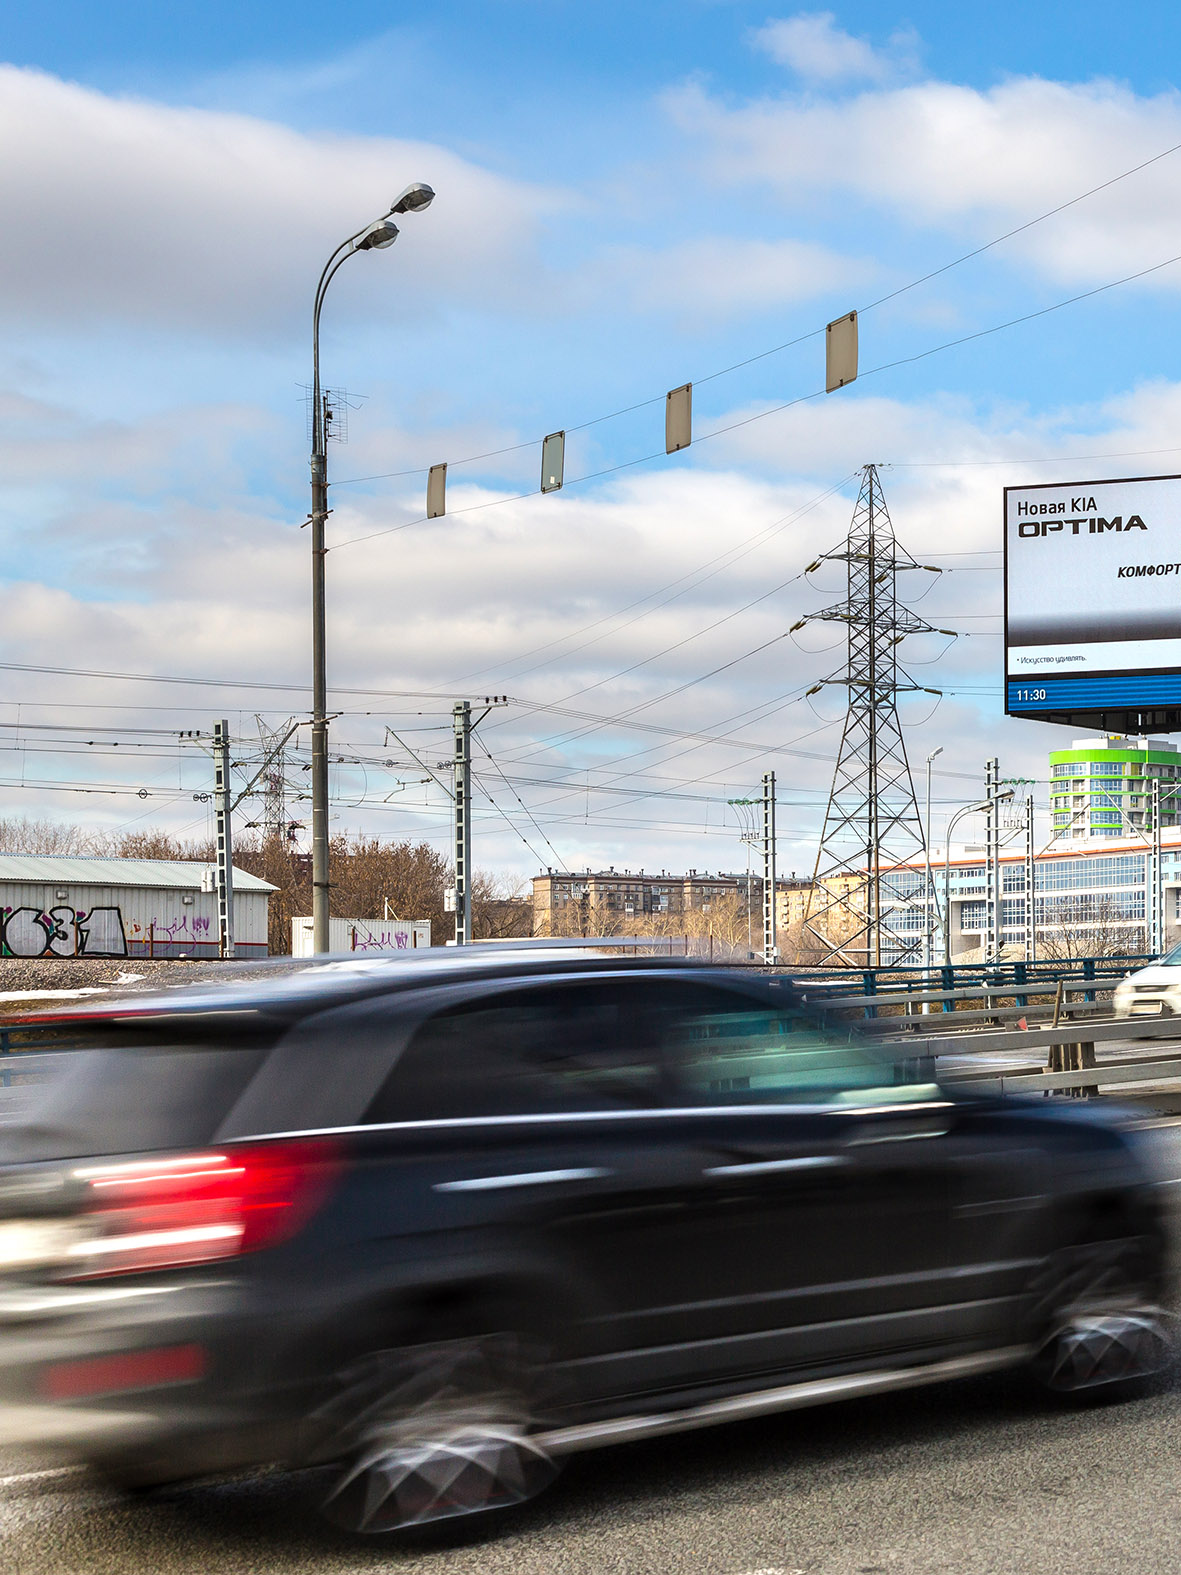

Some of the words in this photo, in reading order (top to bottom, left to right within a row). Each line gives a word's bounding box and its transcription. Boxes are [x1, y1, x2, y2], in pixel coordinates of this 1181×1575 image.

[1018, 501, 1066, 516] Новая
[1071, 497, 1098, 513] KIA
[1018, 515, 1148, 538] OPTIMA
[1117, 563, 1181, 578] КОМФОРТ
[1020, 656, 1054, 665] Искусство
[1017, 689, 1046, 701] 11:30
